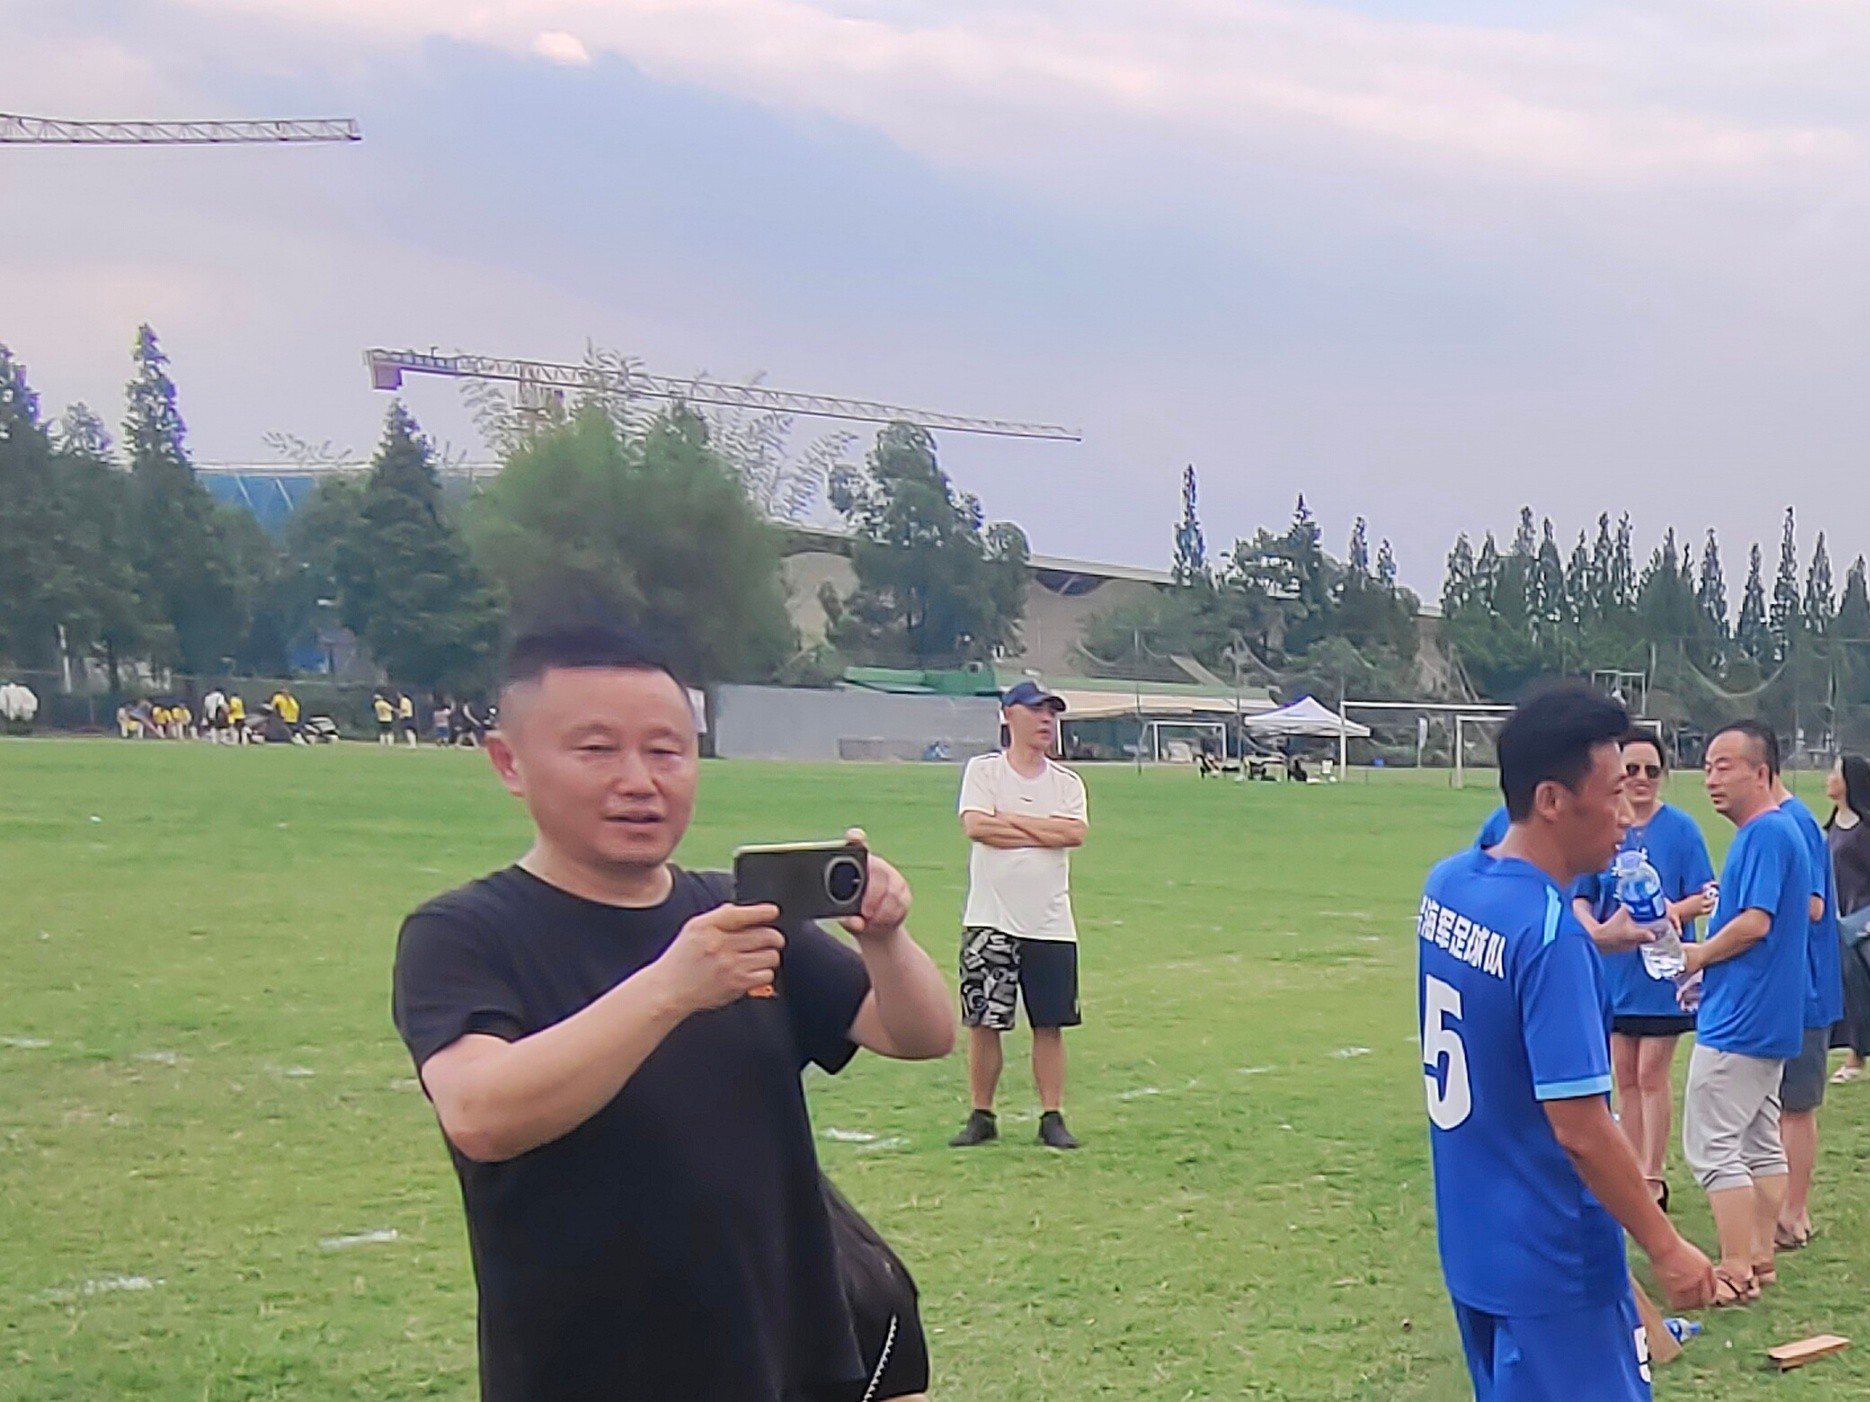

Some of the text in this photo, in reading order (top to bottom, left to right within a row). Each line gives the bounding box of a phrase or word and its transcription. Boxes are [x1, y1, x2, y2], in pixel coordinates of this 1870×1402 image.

[1418, 895, 1506, 979] 海军足球队
[1423, 973, 1472, 1131] 5
